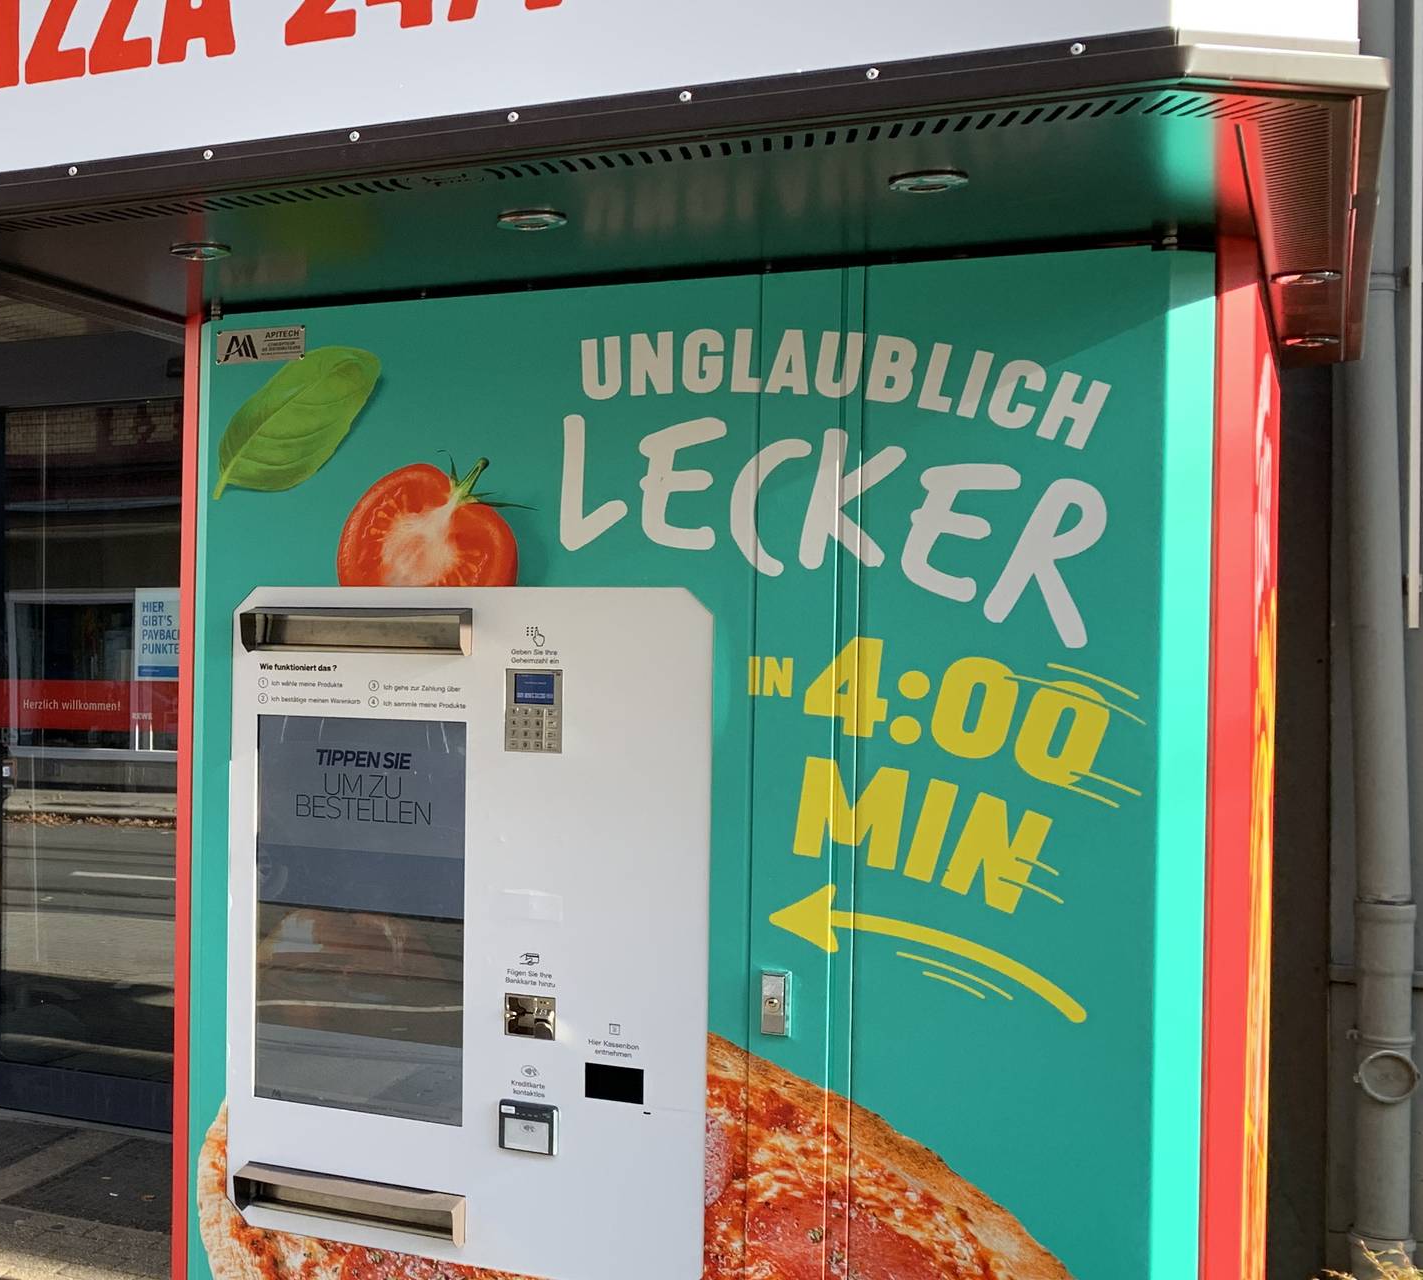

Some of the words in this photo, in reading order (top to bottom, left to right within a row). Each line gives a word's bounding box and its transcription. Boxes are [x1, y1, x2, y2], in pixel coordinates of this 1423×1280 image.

[265, 330, 300, 339] APITECH
[581, 329, 1112, 449] UNGLAUBLICH
[560, 415, 1108, 648] LECKER
[142, 601, 164, 613] HIER
[142, 615, 173, 627] GIBT'S
[511, 648, 532, 656] Geben
[259, 663, 273, 671] Wie
[274, 663, 317, 672] funktioniert
[421, 685, 446, 694] Zahlung
[23, 699, 59, 710] Herzlich
[61, 699, 121, 711] willkommen!
[281, 696, 307, 704] bestätige
[748, 656, 794, 698] IN
[803, 636, 1111, 788] 4:00
[316, 749, 380, 768] TIPPEN
[383, 752, 412, 770] SIE
[324, 772, 363, 796] UM
[368, 774, 402, 799] ZU
[296, 794, 431, 825] BESTELLEN
[793, 756, 1053, 914] MIN
[507, 968, 527, 977] Fügen
[539, 971, 553, 979] Ihre
[505, 976, 537, 986] Bankkarte
[538, 980, 556, 988] hinzu
[603, 1040, 639, 1051] Kassenbon
[594, 1049, 632, 1059] entnehmen
[511, 1080, 545, 1090] Kreditkarte
[512, 1088, 545, 1098] kontaktlos
